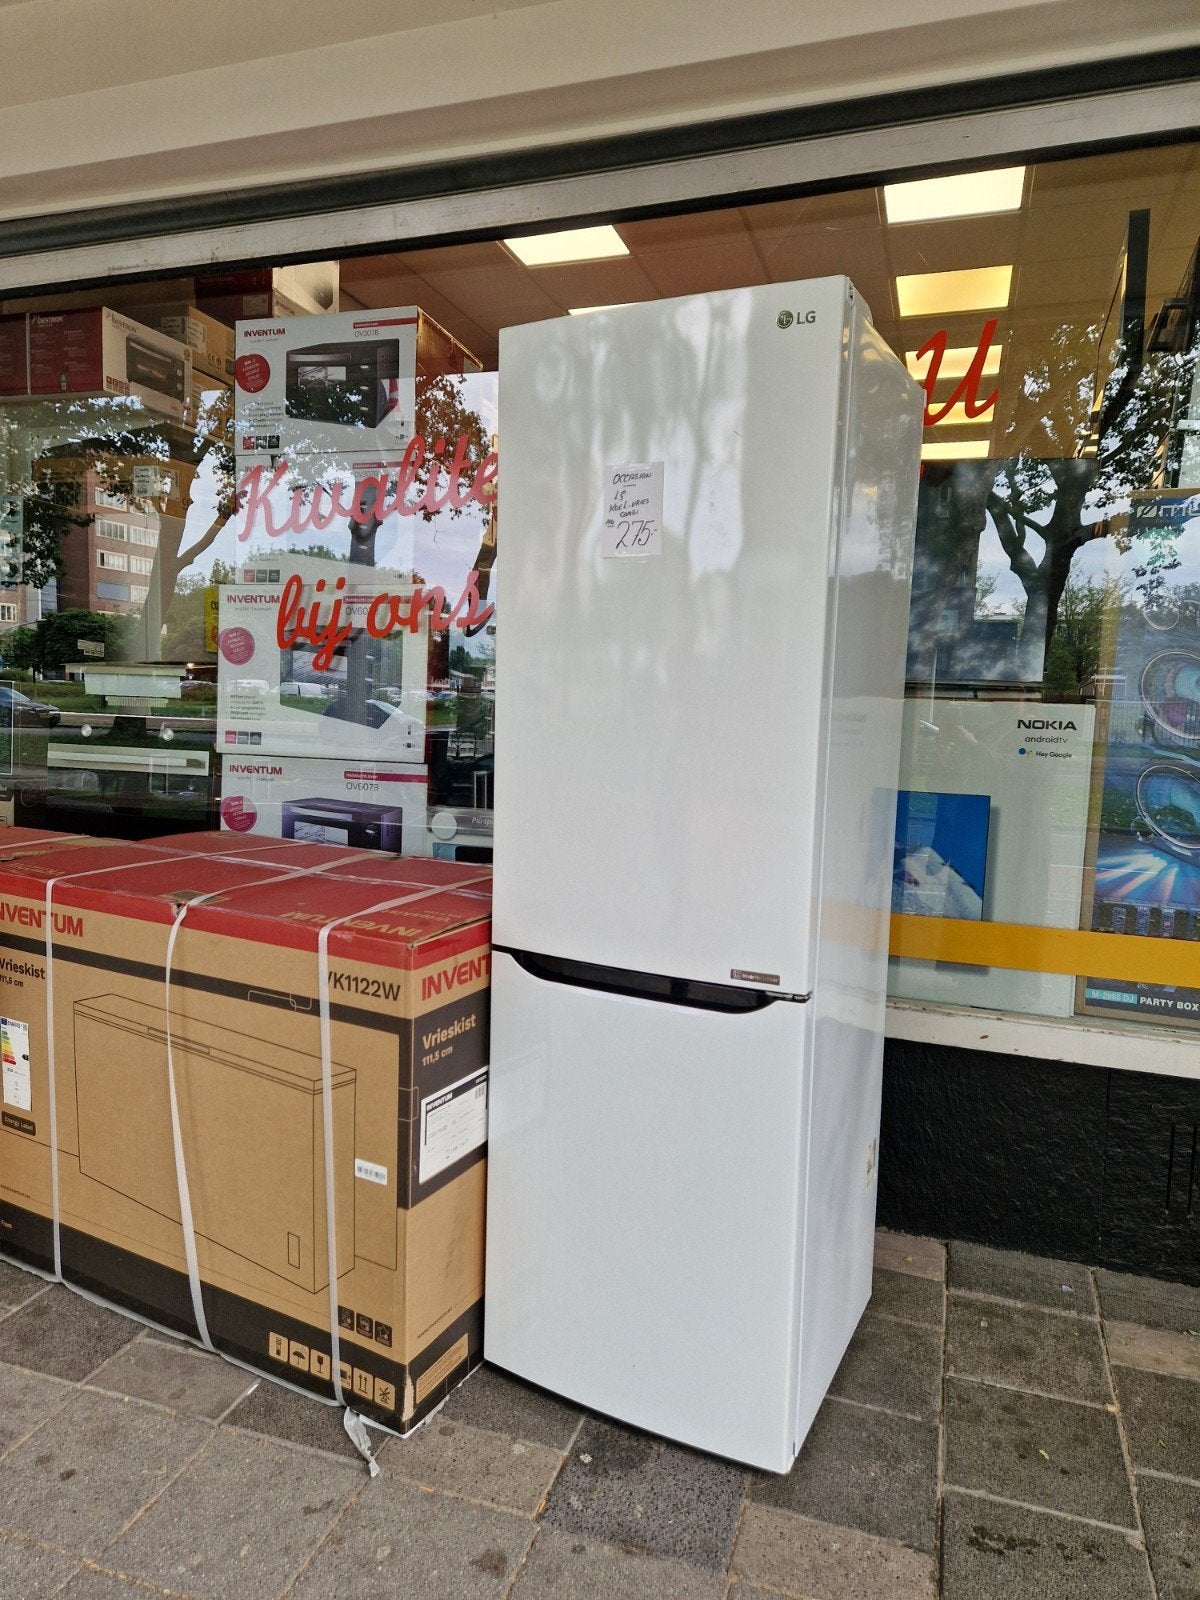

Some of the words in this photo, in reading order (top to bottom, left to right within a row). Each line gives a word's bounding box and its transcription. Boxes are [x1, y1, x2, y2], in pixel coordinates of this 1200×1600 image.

[797, 310, 816, 325] LG
[244, 327, 287, 338] INVENTUM
[354, 329, 380, 338] OV307B
[612, 472, 652, 485] OCCASION
[226, 594, 281, 604] INVENTUM
[277, 574, 353, 671] bij
[366, 570, 495, 639] ons
[1017, 719, 1078, 731] NOKIA
[1035, 750, 1049, 759] Hey
[1049, 751, 1073, 760] Google
[229, 764, 283, 776] INVENTUM
[345, 781, 380, 792] OV607B
[0, 957, 46, 980] Vrieskist
[14, 979, 24, 988] cm
[1139, 996, 1174, 1008] PARTY
[1176, 1001, 1200, 1012] BOX
[421, 1013, 477, 1050] Vrieskist
[421, 1050, 440, 1067] 111,5
[441, 1045, 454, 1059] cm
